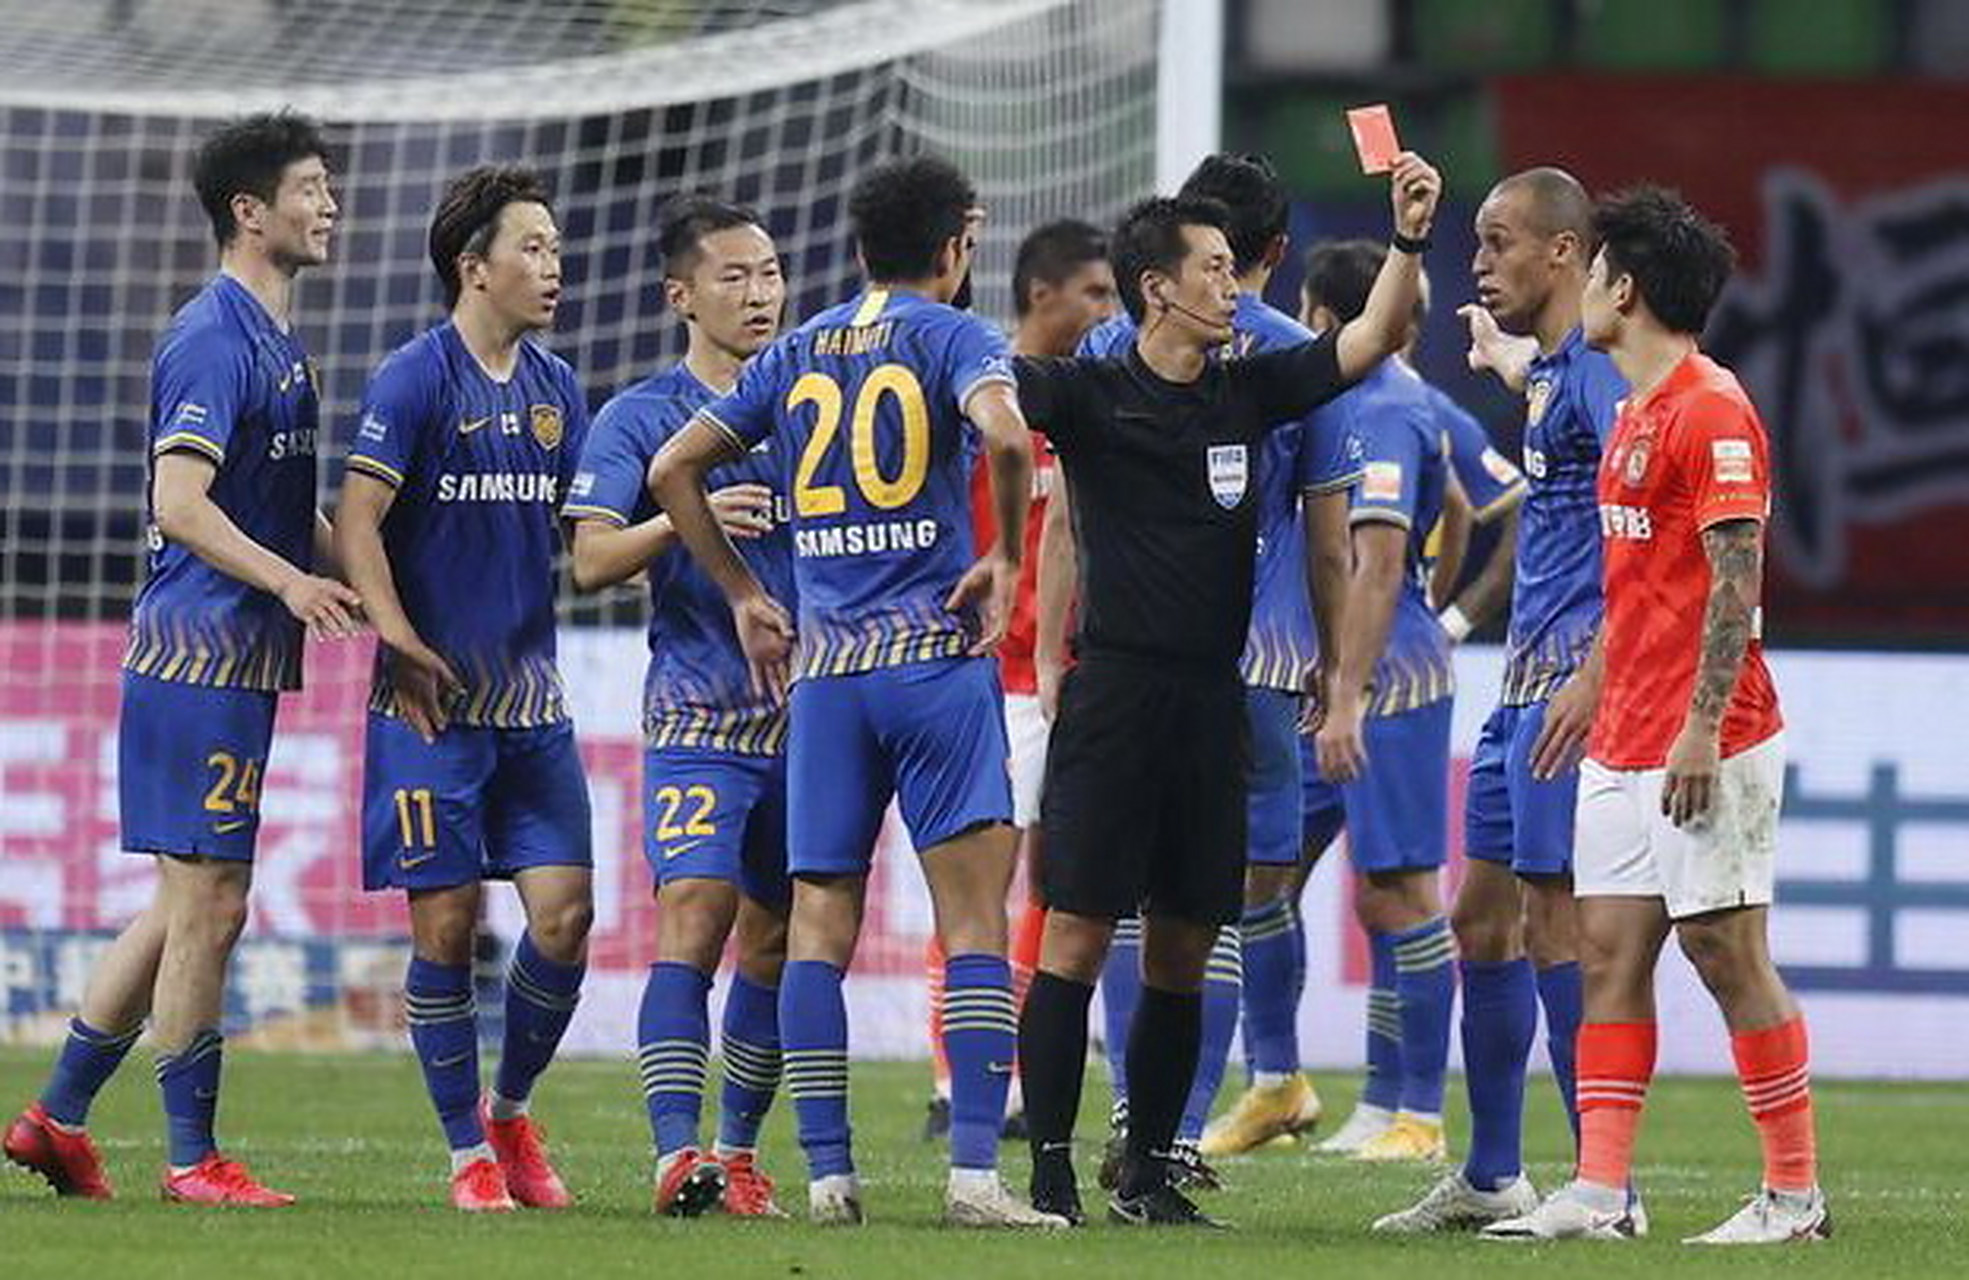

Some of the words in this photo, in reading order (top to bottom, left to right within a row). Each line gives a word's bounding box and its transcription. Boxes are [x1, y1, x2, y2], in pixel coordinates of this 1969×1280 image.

[787, 363, 930, 517] 20
[204, 750, 260, 811] 24
[394, 788, 435, 848] 11
[655, 785, 717, 842] 22
